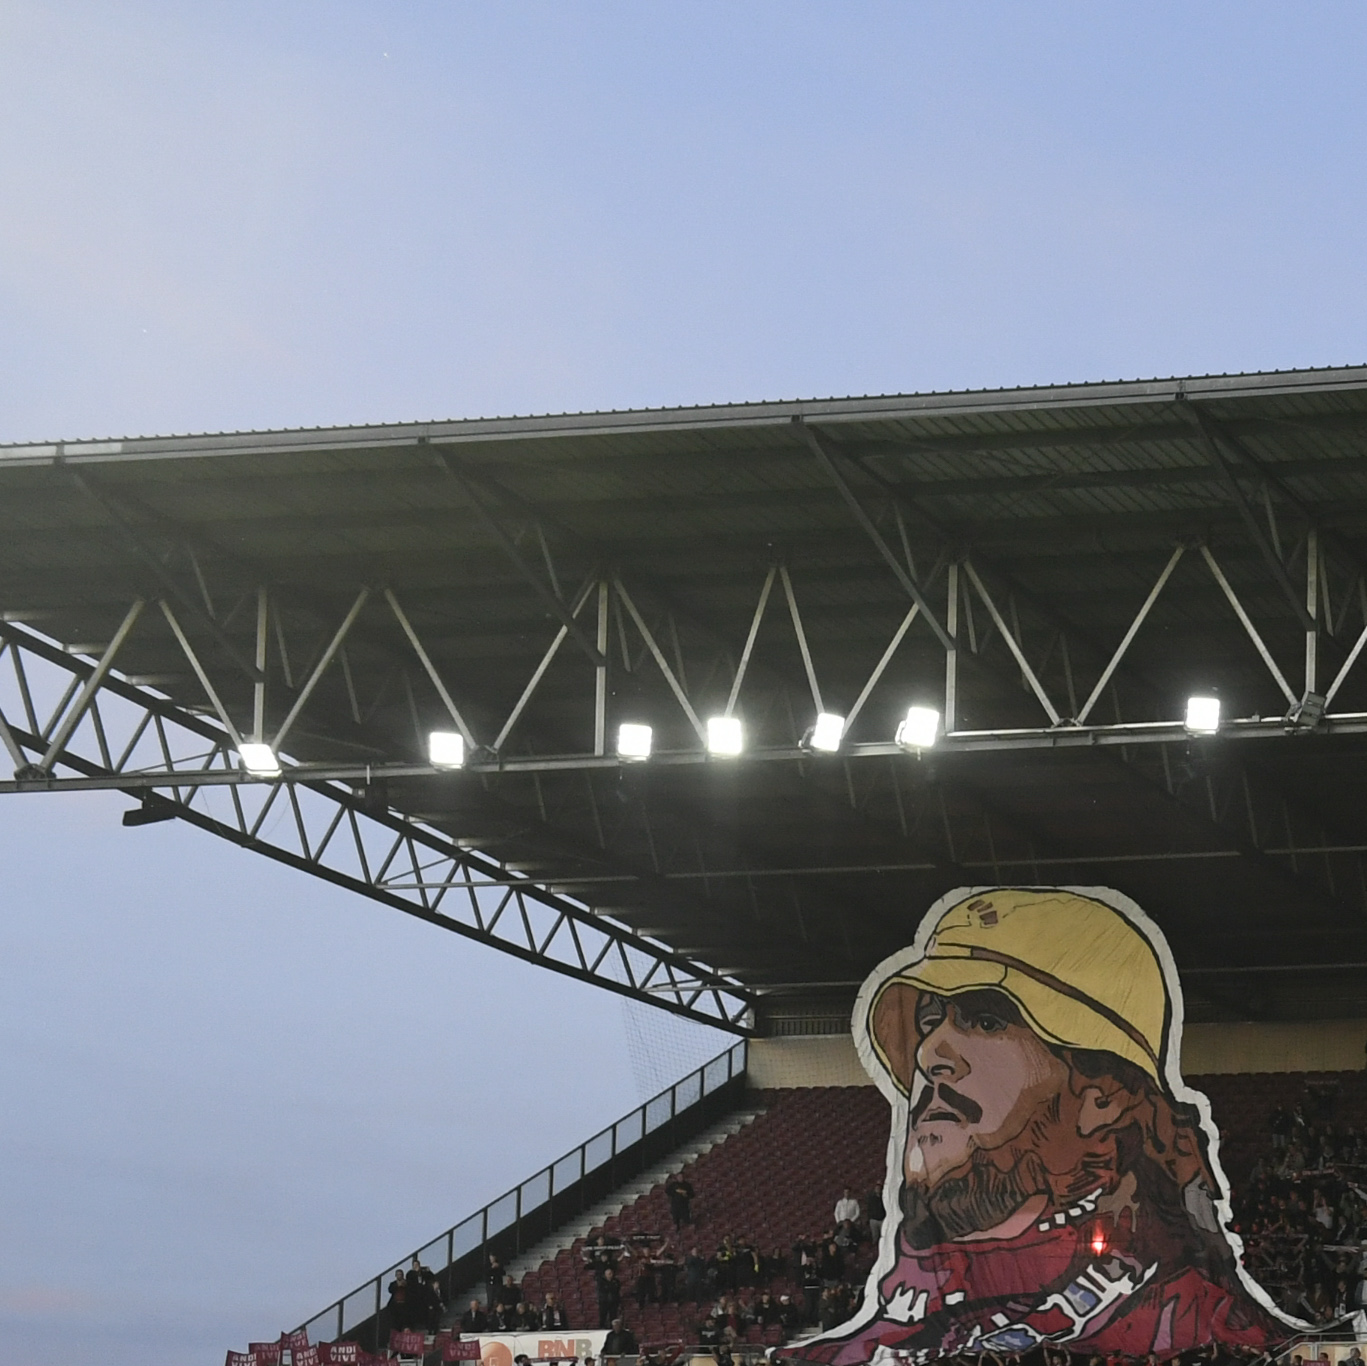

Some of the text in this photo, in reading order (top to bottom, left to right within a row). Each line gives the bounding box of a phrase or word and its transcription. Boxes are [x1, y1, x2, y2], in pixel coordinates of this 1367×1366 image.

[330, 1345, 356, 1354] ANDI
[232, 1353, 256, 1362] ANDI
[330, 1354, 356, 1363] VIVE
